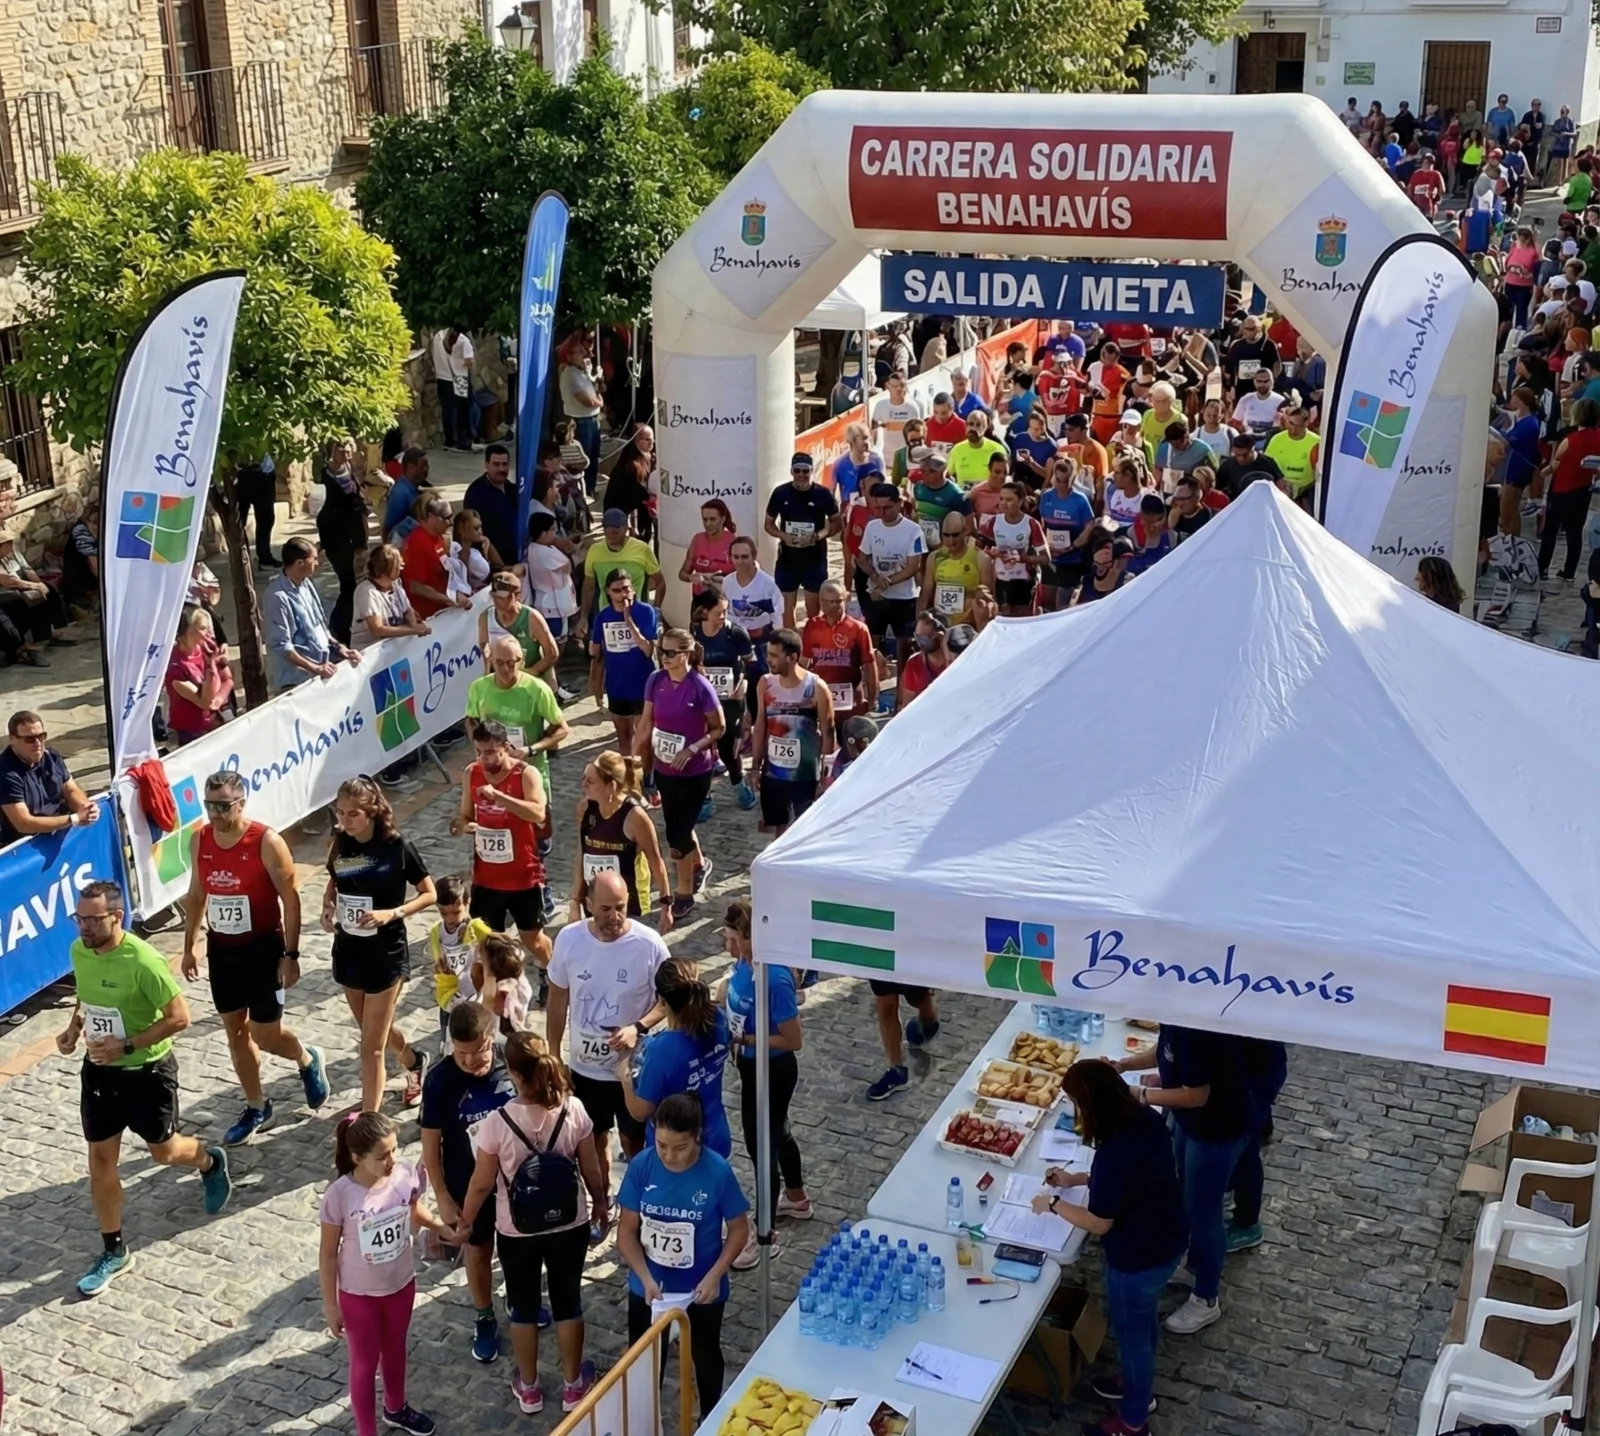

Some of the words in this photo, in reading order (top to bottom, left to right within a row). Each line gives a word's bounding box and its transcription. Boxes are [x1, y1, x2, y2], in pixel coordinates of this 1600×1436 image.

[861, 139, 1018, 179] CARRERA
[1028, 142, 1217, 183] SOLIDARIA
[937, 187, 1132, 230] BENAHAVÍS
[709, 246, 801, 278] Benahavís
[903, 269, 1045, 309] SALIDA
[1056, 274, 1068, 311] /
[1081, 276, 1195, 315] META
[1388, 271, 1444, 398] Benahavís
[154, 316, 212, 487] Benahavís
[670, 404, 752, 434] Benahavís
[671, 475, 753, 500] Benahavís
[1371, 536, 1446, 566] nahavís
[774, 744, 795, 758] 126
[218, 906, 243, 922] 173
[1072, 929, 1355, 1017] Benahavís
[582, 1040, 611, 1057] 749
[650, 1232, 683, 1254] 173
